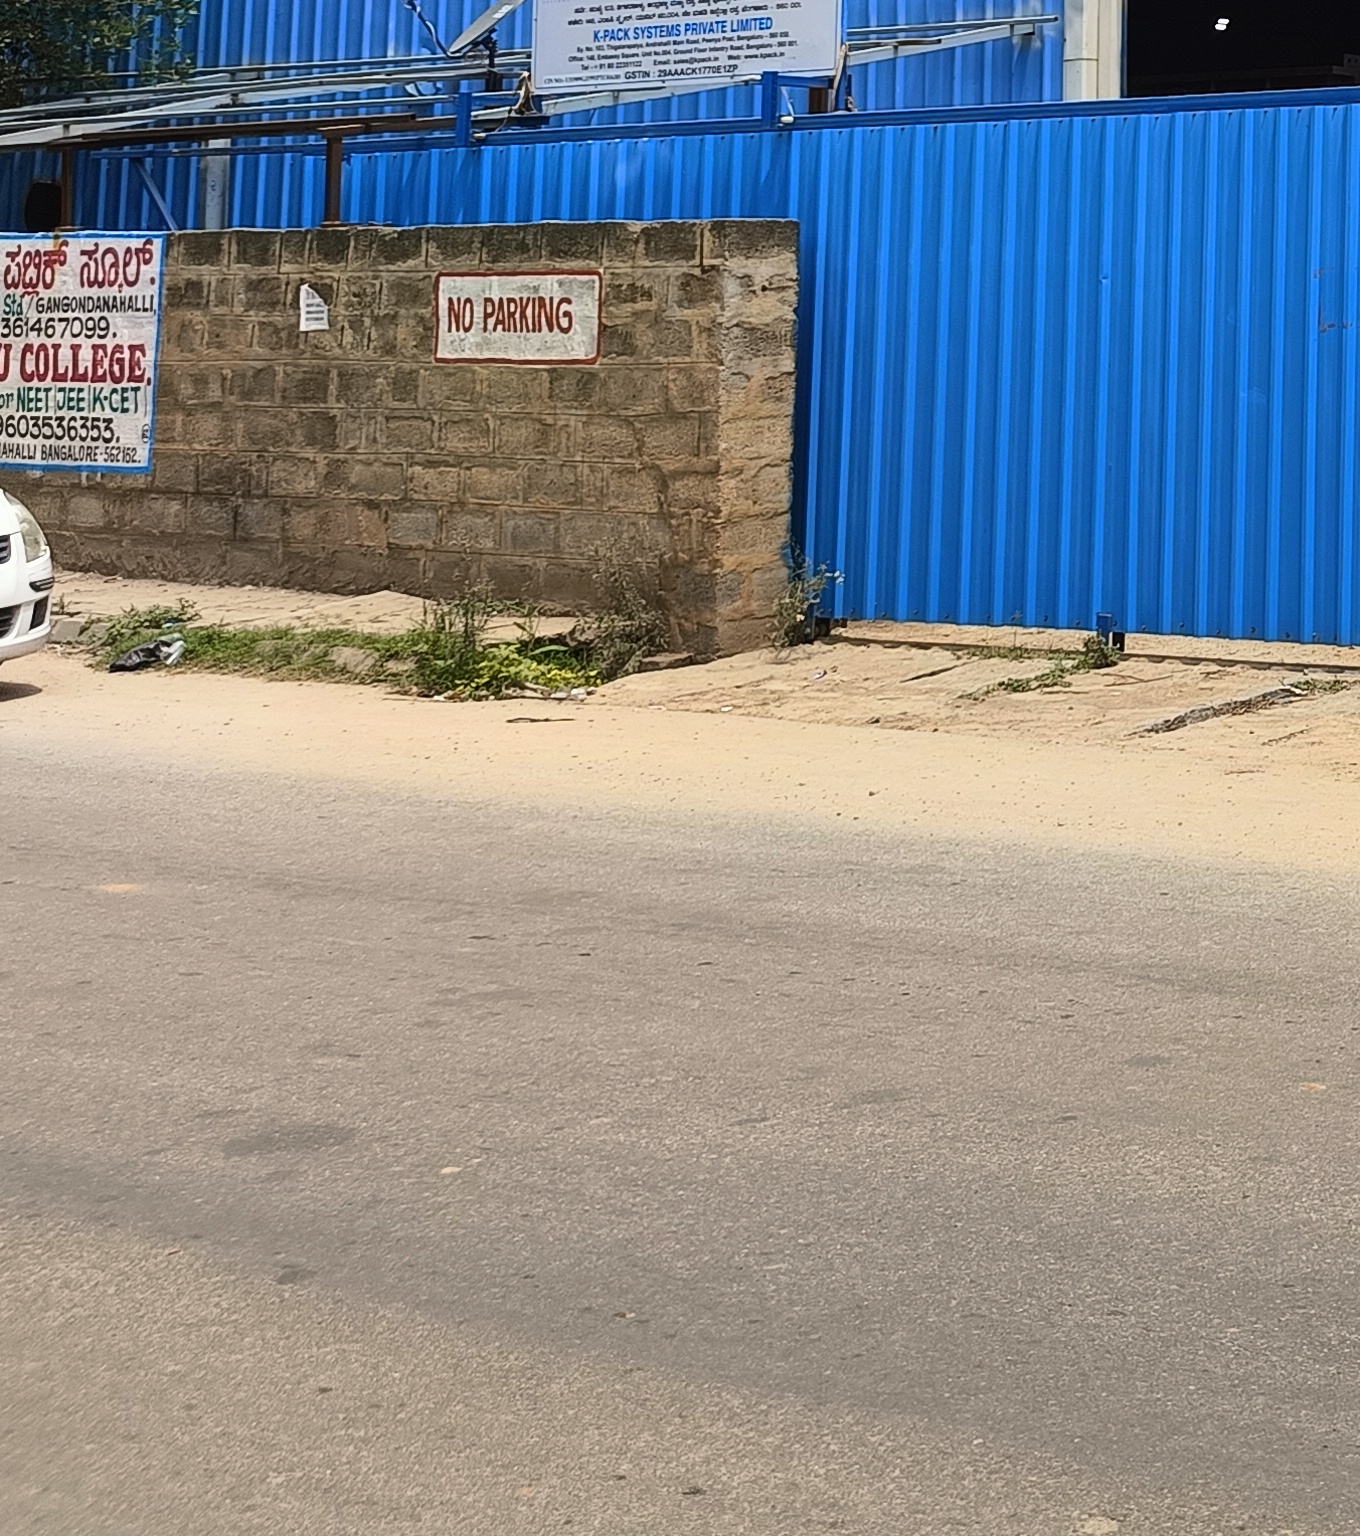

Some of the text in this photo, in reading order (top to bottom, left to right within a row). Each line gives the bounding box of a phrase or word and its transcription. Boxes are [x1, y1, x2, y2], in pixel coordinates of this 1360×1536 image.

[593, 17, 773, 43] K-PACK SYSTEMS PRIVATE LIMITED
[624, 70, 651, 80] GSTIN
[3, 293, 24, 316] Std
[447, 296, 573, 335] NO PARKING
[20, 343, 152, 386] COLLEGE.
[16, 386, 52, 413] NEET
[57, 386, 85, 412] JEE
[0, 443, 37, 460] AHALLI
